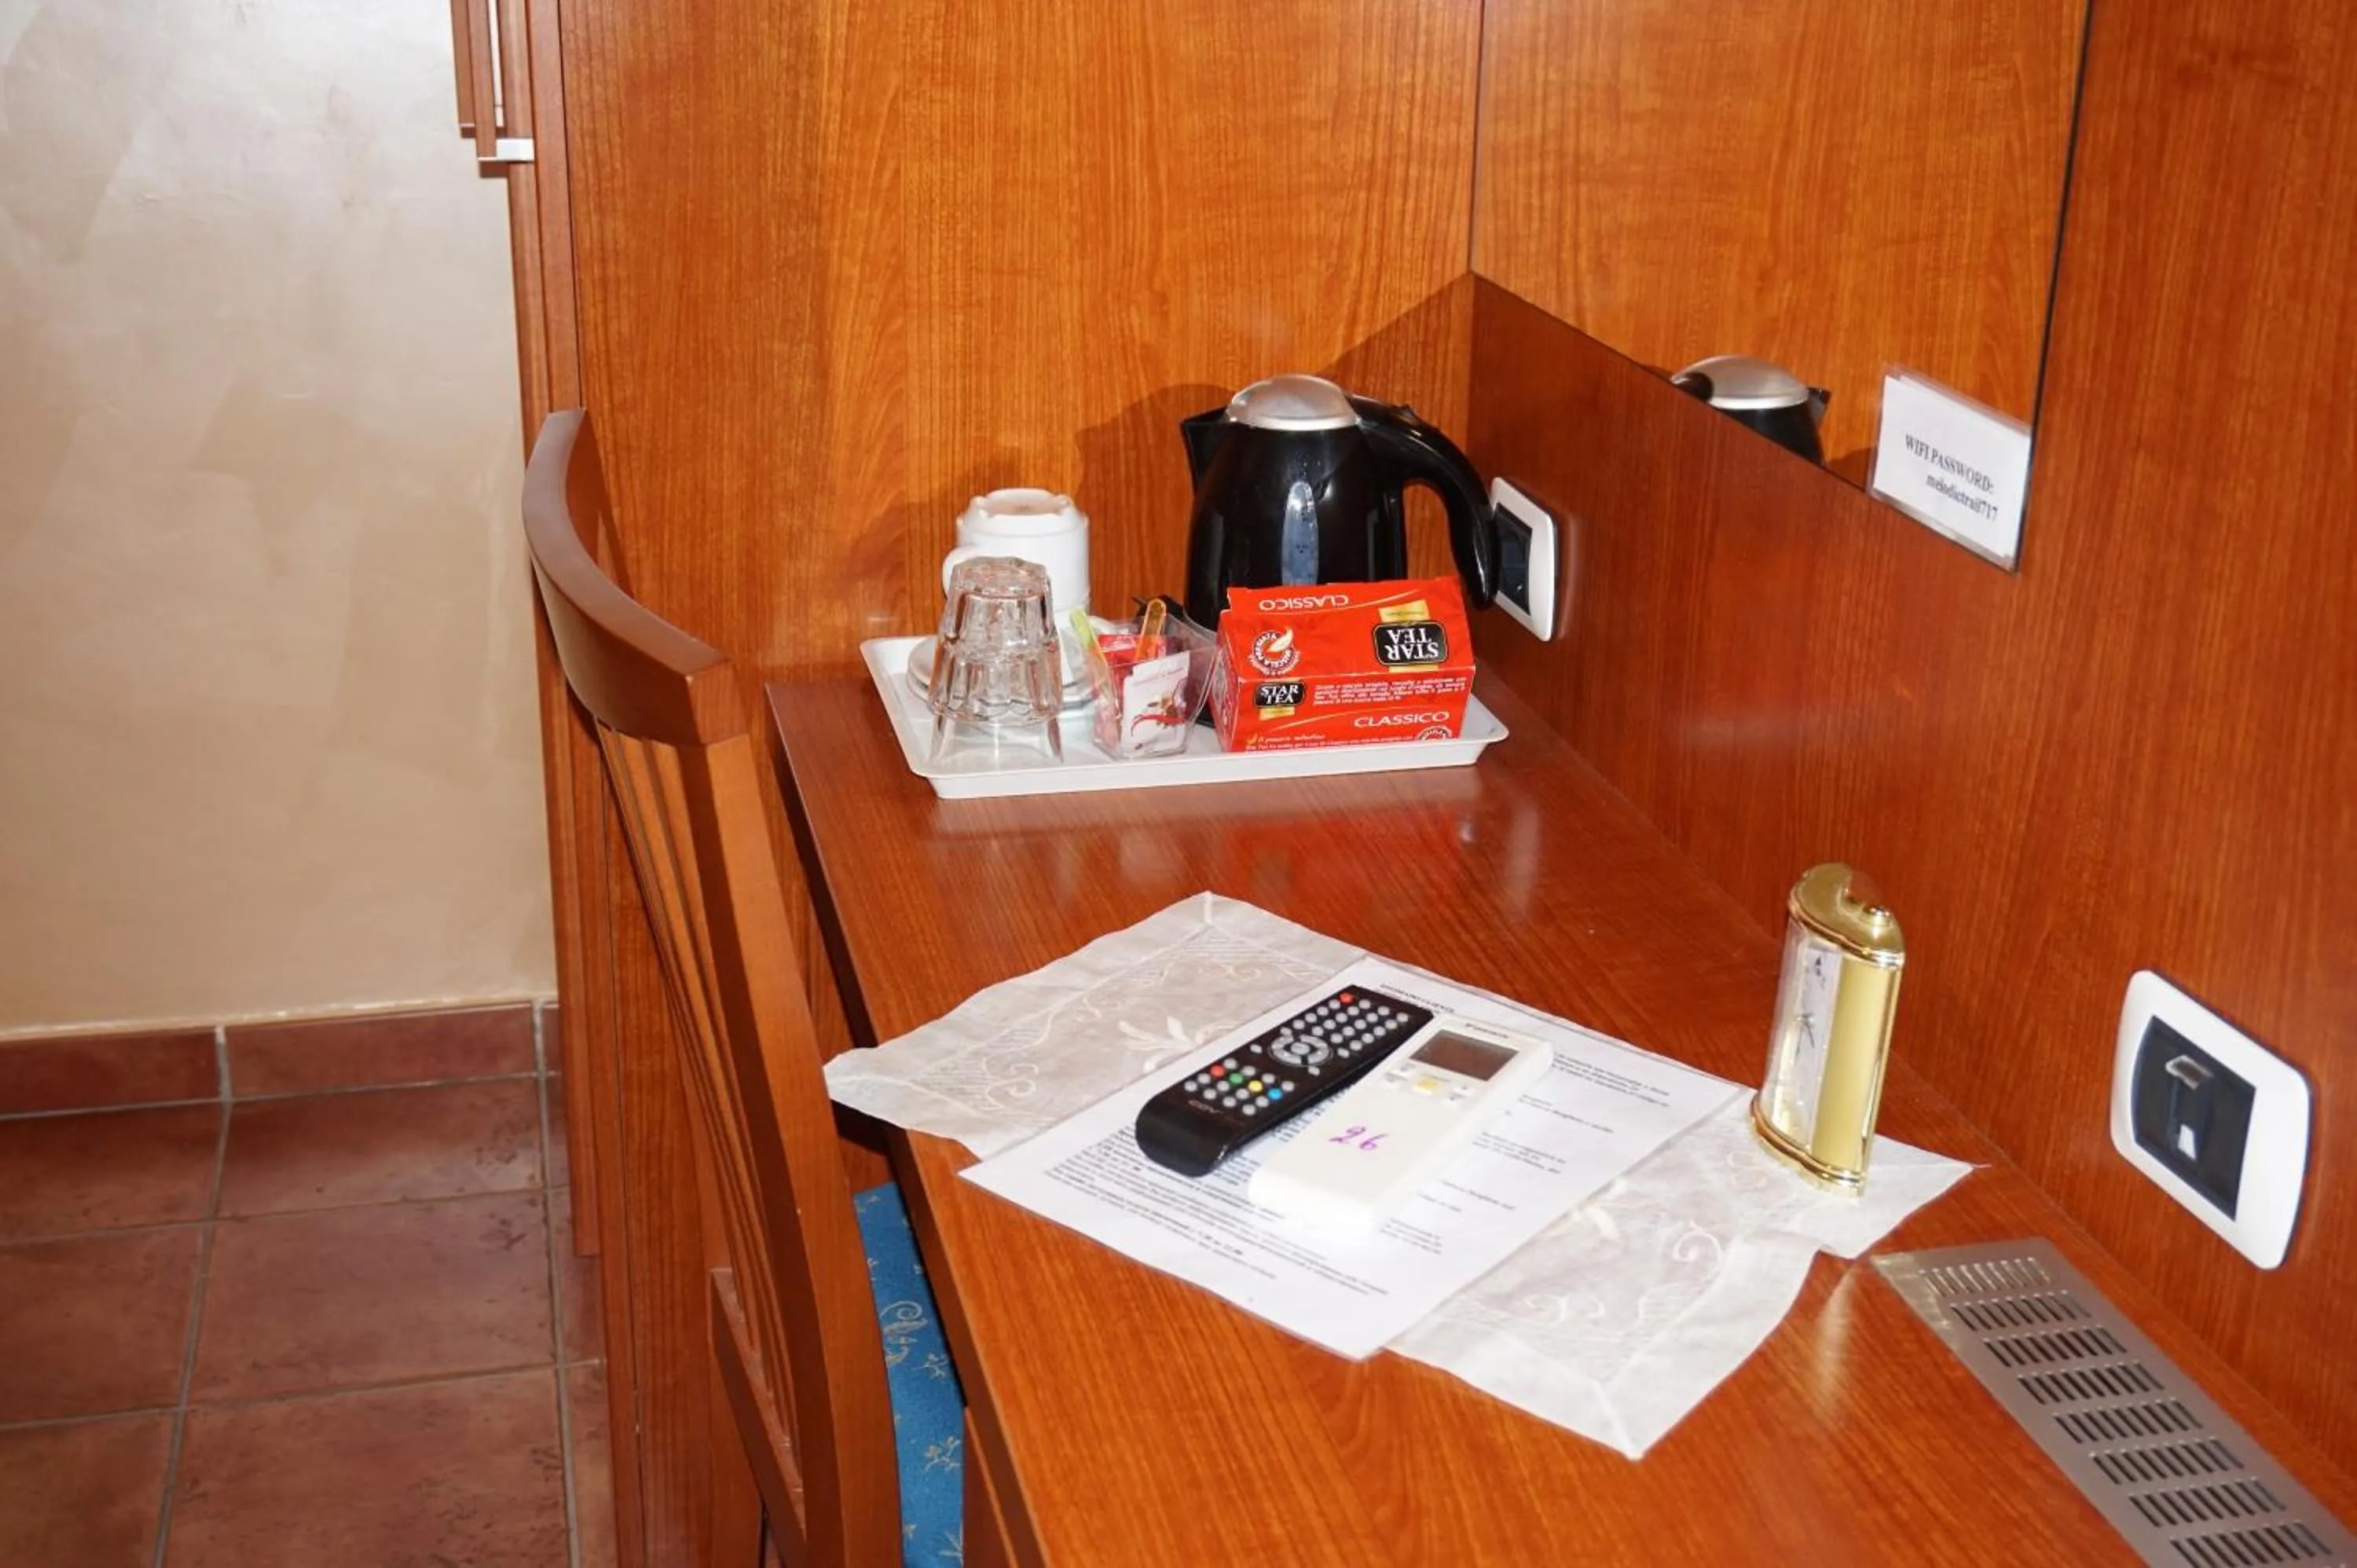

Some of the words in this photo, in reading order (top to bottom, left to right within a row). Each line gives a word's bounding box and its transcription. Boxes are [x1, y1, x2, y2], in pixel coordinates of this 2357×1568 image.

[1905, 434, 1930, 460] WIFI
[1931, 449, 1993, 494] PASSWORD:
[1259, 594, 1350, 611] CLASSICO
[1387, 628, 1432, 643] TEA
[1386, 642, 1439, 661] STAR
[1260, 684, 1299, 695] STAR
[1266, 693, 1296, 704] TEA
[1354, 712, 1450, 728] CLASSICO
[1328, 1126, 1390, 1152] 26
